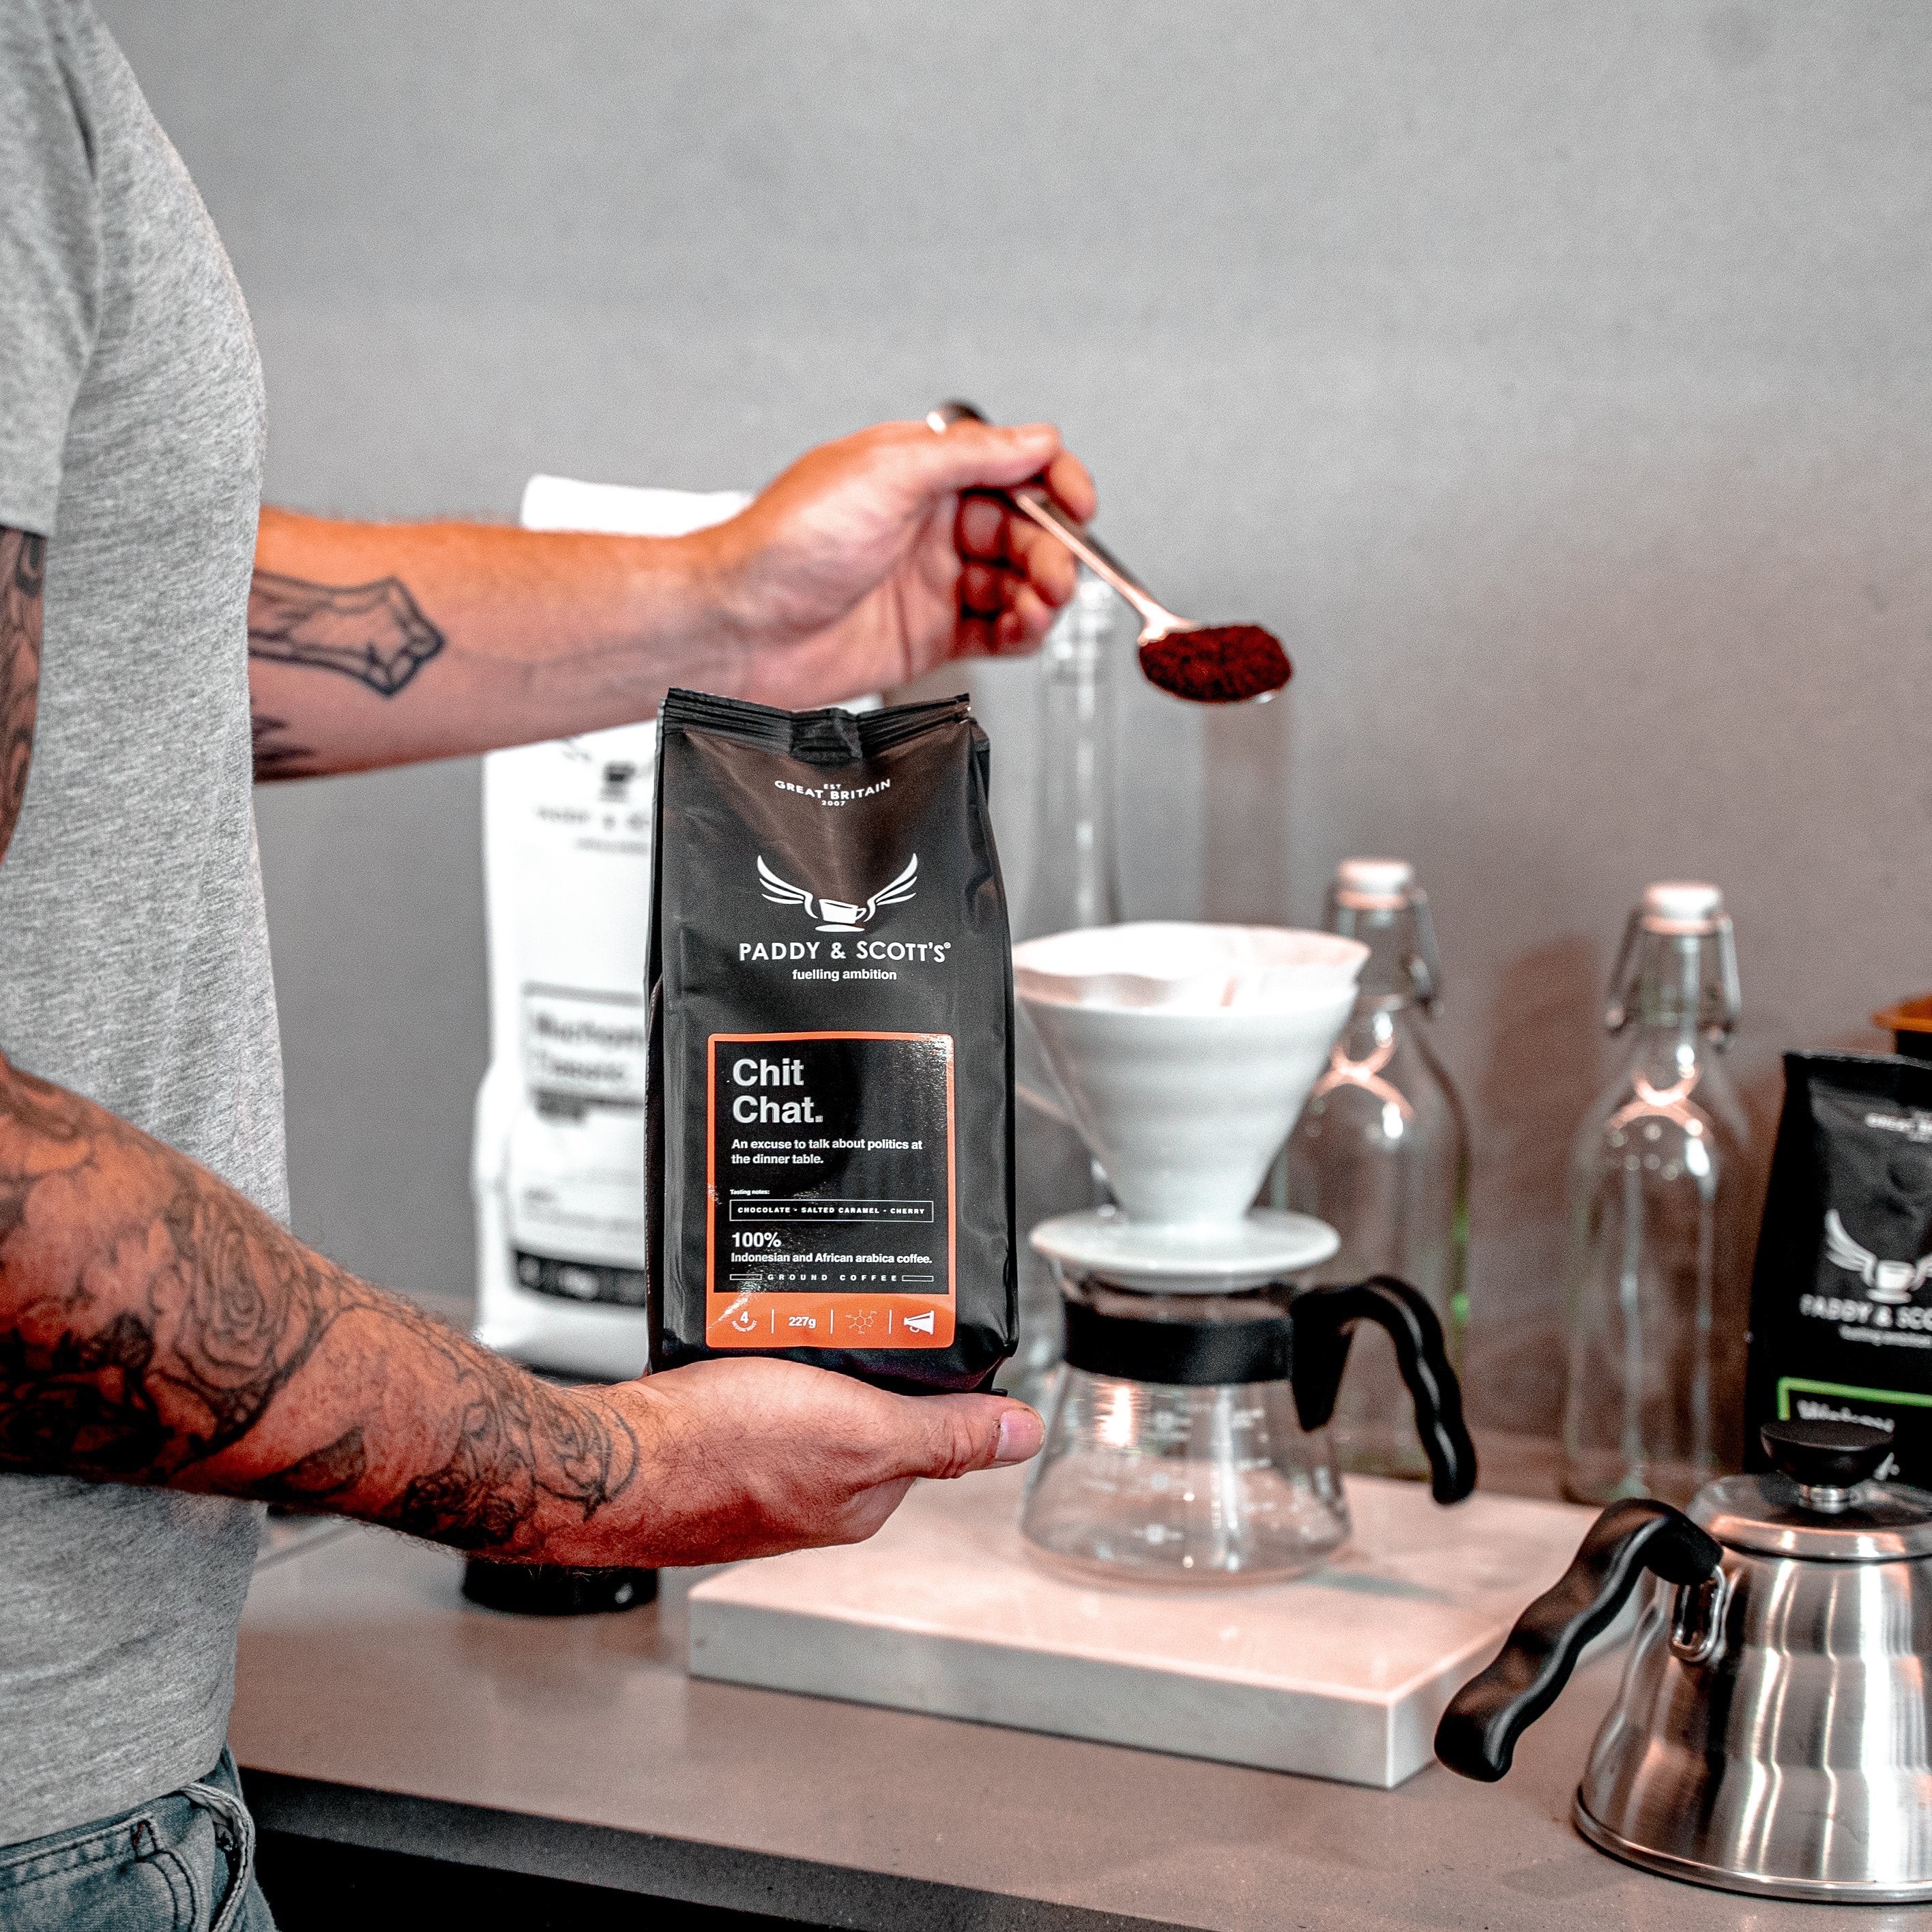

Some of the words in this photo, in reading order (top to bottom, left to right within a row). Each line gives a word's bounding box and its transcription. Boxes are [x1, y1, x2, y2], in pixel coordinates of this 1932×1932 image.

[774, 780, 823, 799] GREAT
[830, 778, 891, 800] BRITAIN
[739, 941, 820, 961] PADDY
[830, 942, 847, 959] &
[792, 969, 840, 982] fuelling
[843, 969, 898, 980] ambition
[732, 1057, 804, 1086] Chit
[732, 1095, 823, 1124] Chat.
[731, 1139, 748, 1149] An
[750, 1141, 792, 1150] excuse
[794, 1139, 806, 1149] to
[808, 1139, 830, 1149] talk
[832, 1139, 866, 1149] about
[868, 1139, 909, 1151] politics
[911, 1140, 923, 1150] at
[731, 1154, 750, 1164] the
[752, 1154, 790, 1164] dinner
[792, 1154, 824, 1164] table.
[732, 1232, 782, 1248] 100%
[731, 1253, 791, 1263] Indonesian
[793, 1253, 813, 1263] and
[815, 1253, 853, 1263] African
[855, 1253, 895, 1263] arabica
[897, 1253, 933, 1264] coffee.
[740, 1311, 749, 1323] 4
[788, 1316, 817, 1329] 227g
